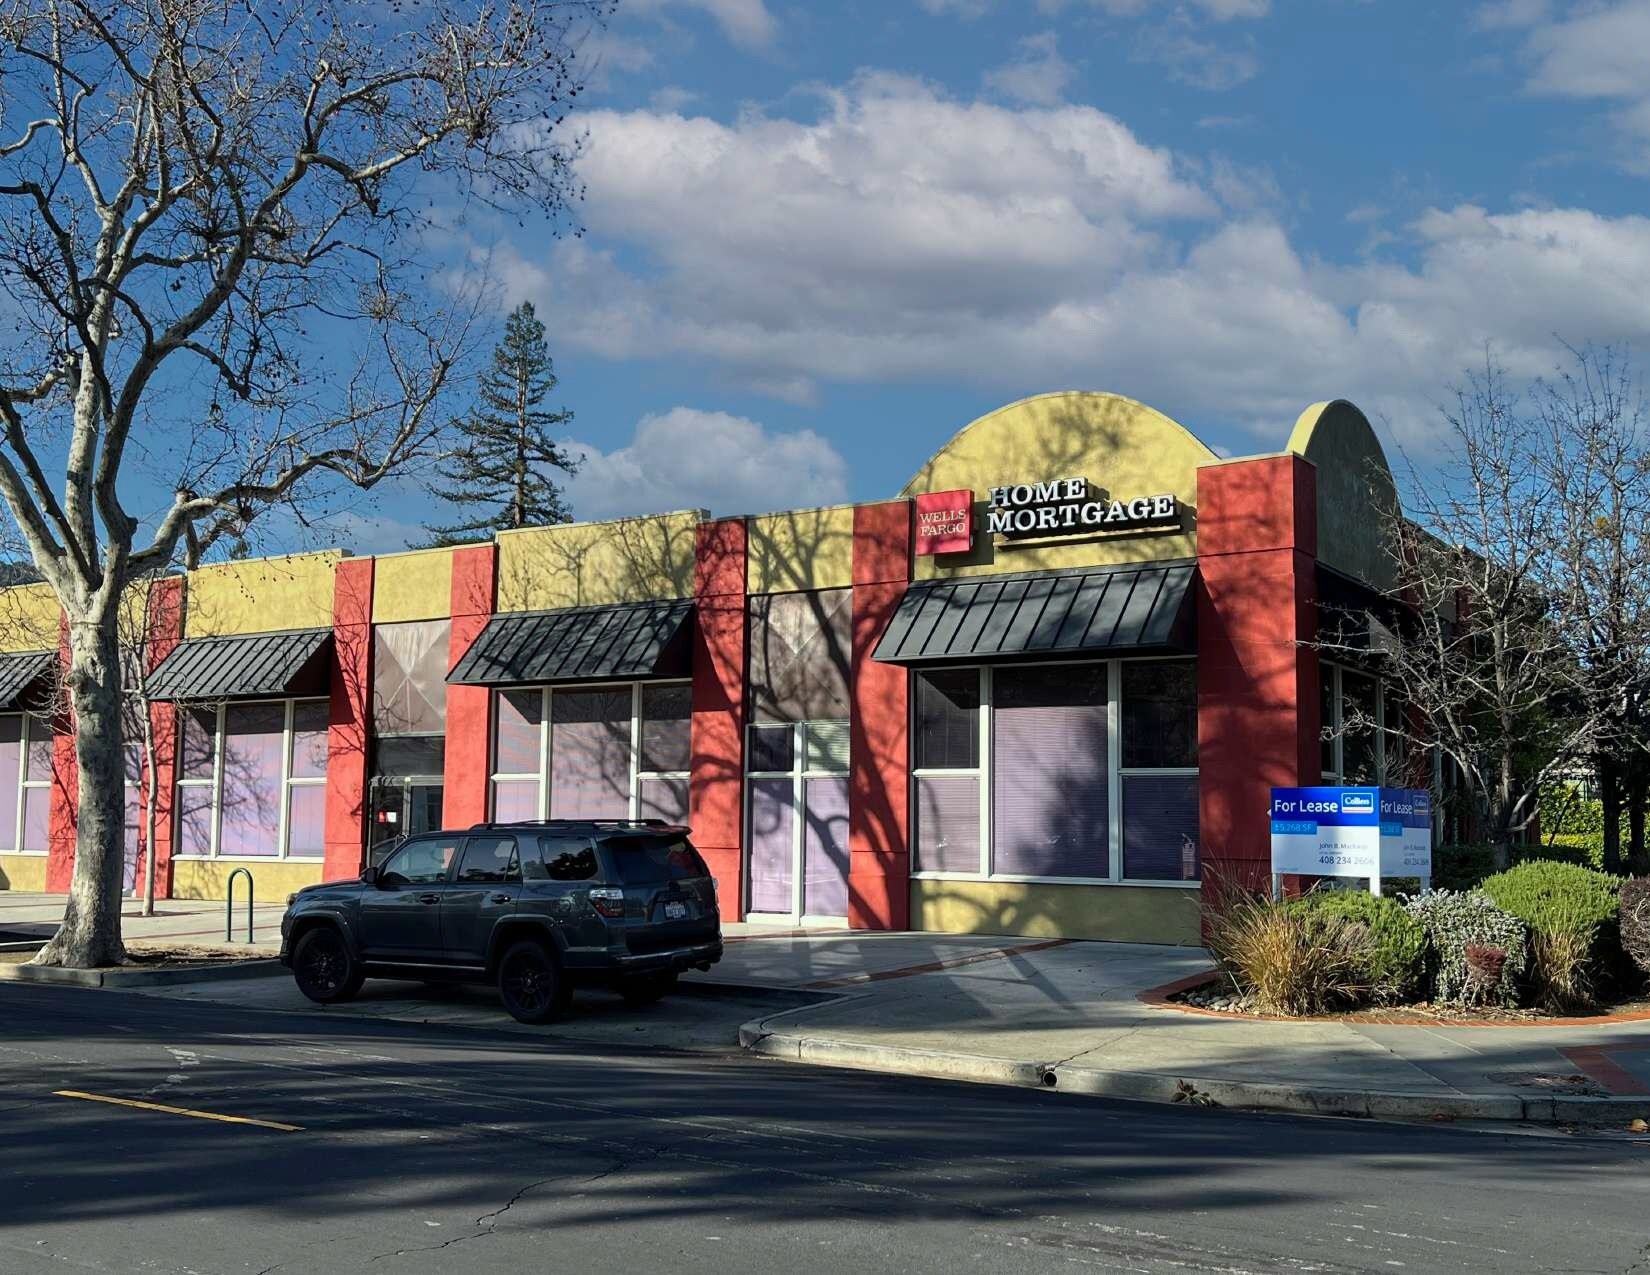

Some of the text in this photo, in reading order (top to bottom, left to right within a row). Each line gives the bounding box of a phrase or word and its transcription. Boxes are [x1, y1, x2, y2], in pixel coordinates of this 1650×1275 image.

[988, 477, 1087, 509] HOME
[919, 508, 966, 523] WELLS
[987, 494, 1176, 533] MORTGAGE
[920, 522, 966, 537] FARGO
[1274, 799, 1338, 813] For Lease
[1344, 796, 1370, 806] Colliers
[1380, 800, 1413, 815] For Lease
[1318, 855, 1335, 865] 408
[1336, 855, 1352, 865] 234
